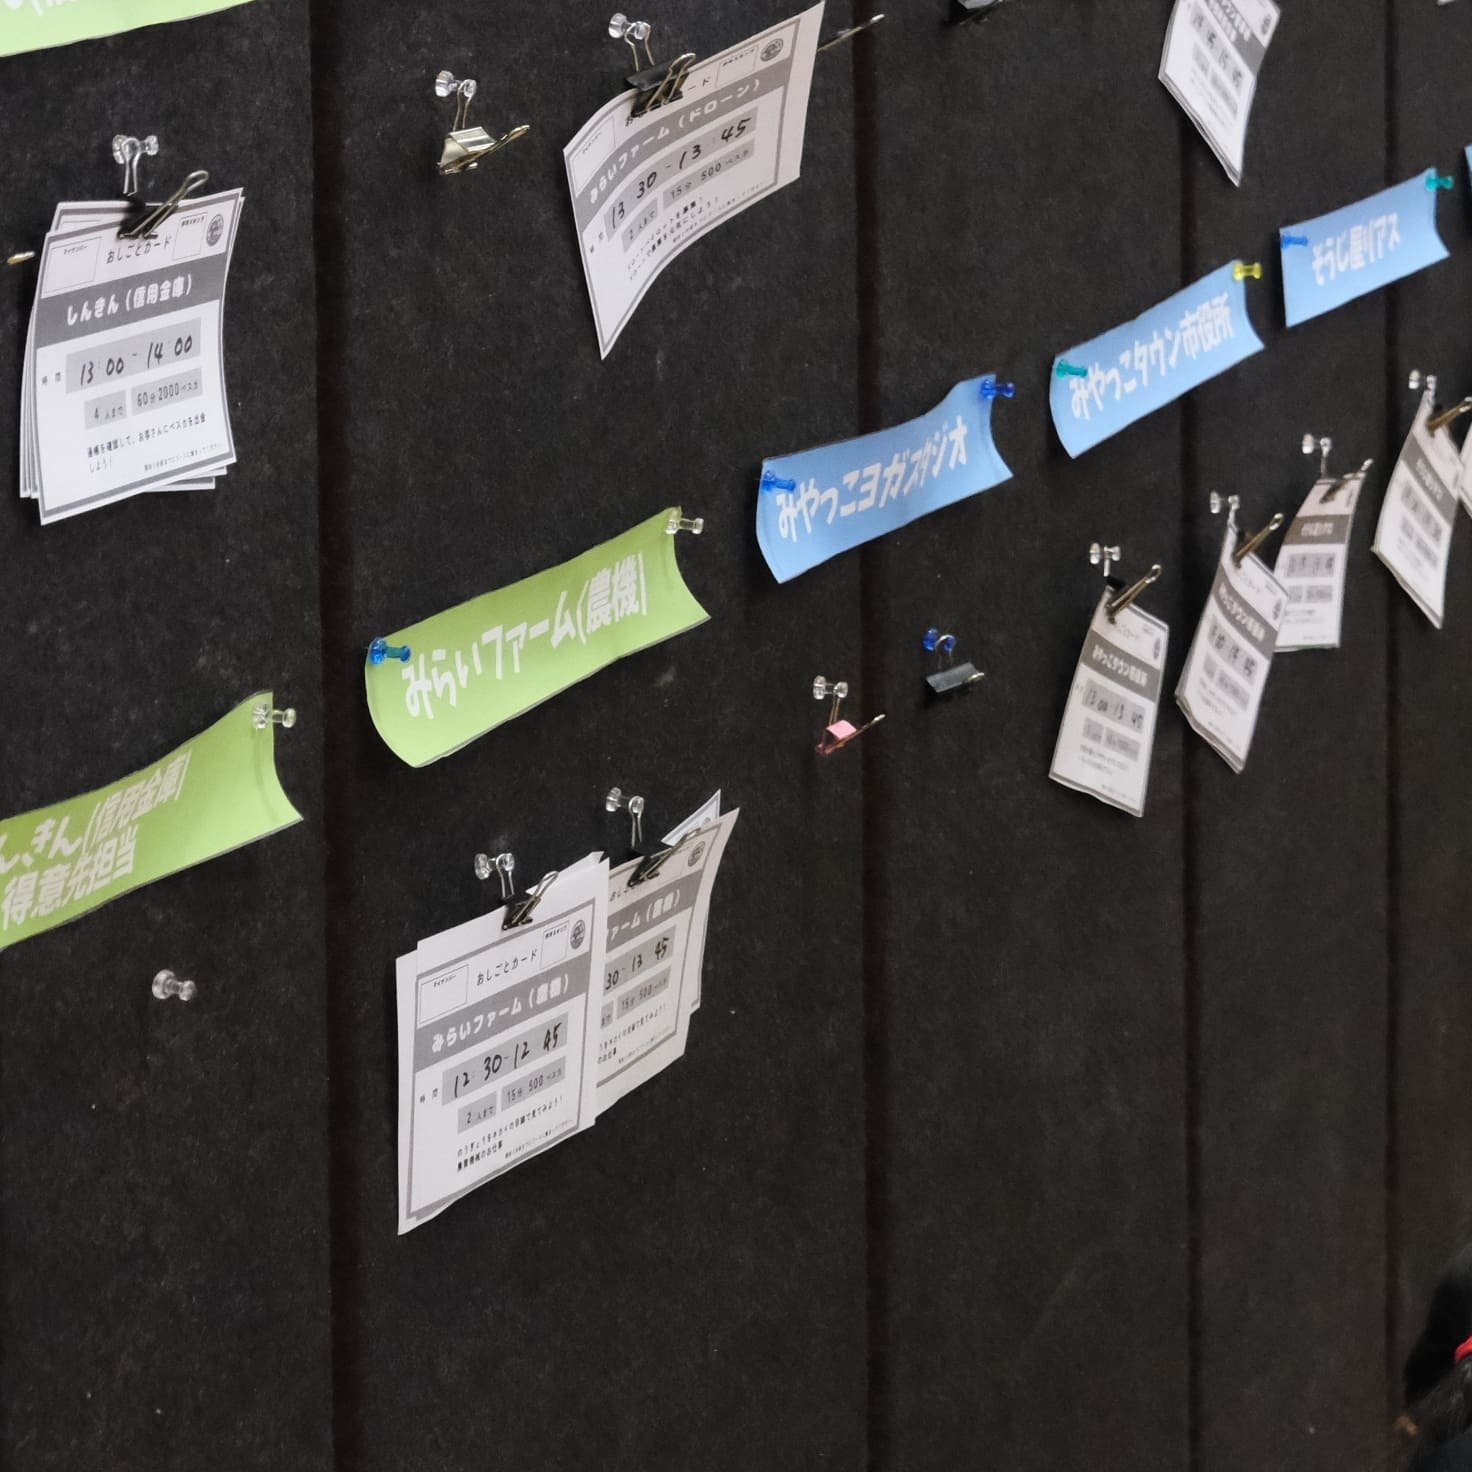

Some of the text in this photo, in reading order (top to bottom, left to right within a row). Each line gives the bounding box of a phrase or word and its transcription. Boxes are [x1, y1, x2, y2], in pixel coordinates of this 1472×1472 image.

[611, 117, 752, 230] 13 30 13 45
[700, 160, 722, 181] 500
[105, 235, 172, 264] おしごとカード
[1310, 212, 1402, 288] そうじ屋リアス
[65, 274, 193, 326] しんきん（信用金庫）
[80, 335, 193, 386] 13 00 14 00
[1067, 292, 1235, 420] みやっこタウン市役所
[776, 416, 969, 543] みやっこヨガスタジオ
[1, 822, 139, 930] 得意先担当
[475, 949, 539, 987] おしごとカード
[653, 937, 670, 962] 45
[453, 1021, 562, 1098] 12 30 12 45
